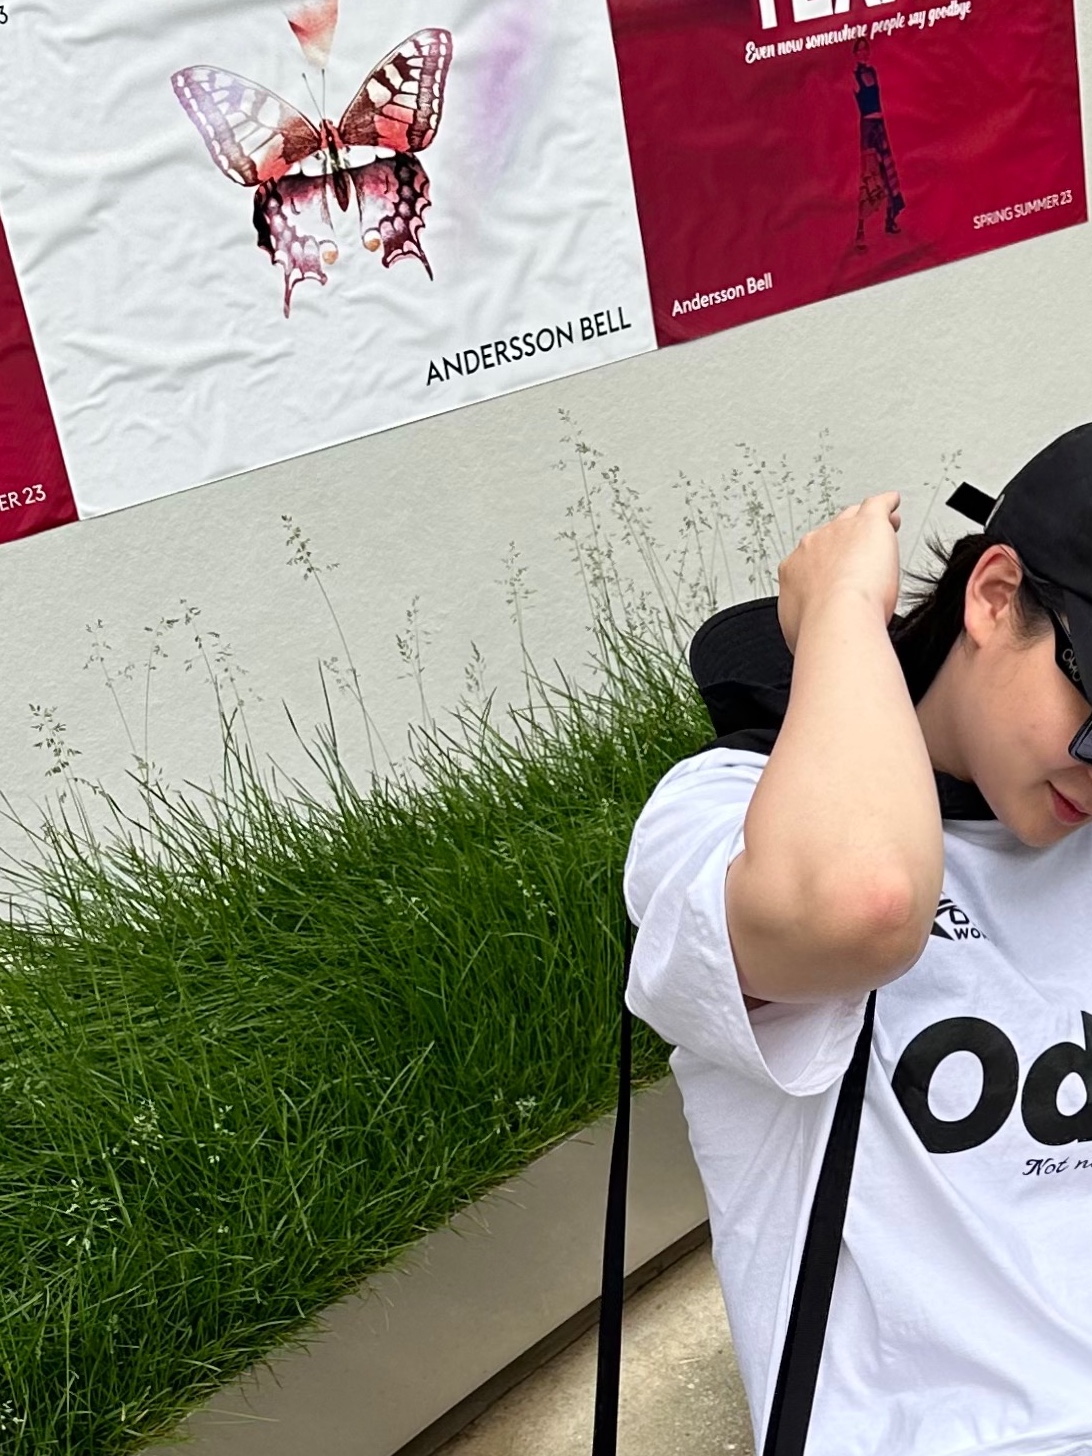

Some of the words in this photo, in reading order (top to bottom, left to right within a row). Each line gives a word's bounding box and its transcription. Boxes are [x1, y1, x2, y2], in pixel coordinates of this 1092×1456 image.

[744, 41, 776, 64] Even
[777, 36, 804, 56] now
[805, 23, 867, 51] somewhere
[870, 11, 906, 40] people
[907, 9, 926, 30] say
[928, 0, 972, 27] goodbye
[973, 206, 1014, 230] SPRING
[1014, 193, 1060, 219] SUMMER
[1060, 189, 1073, 206] 23
[671, 284, 746, 318] Andersson
[746, 271, 774, 295] Bell
[425, 321, 575, 387] ANDERSSON
[579, 306, 632, 342] BELL
[22, 484, 47, 505] 23
[1022, 1157, 1069, 1177] Not
